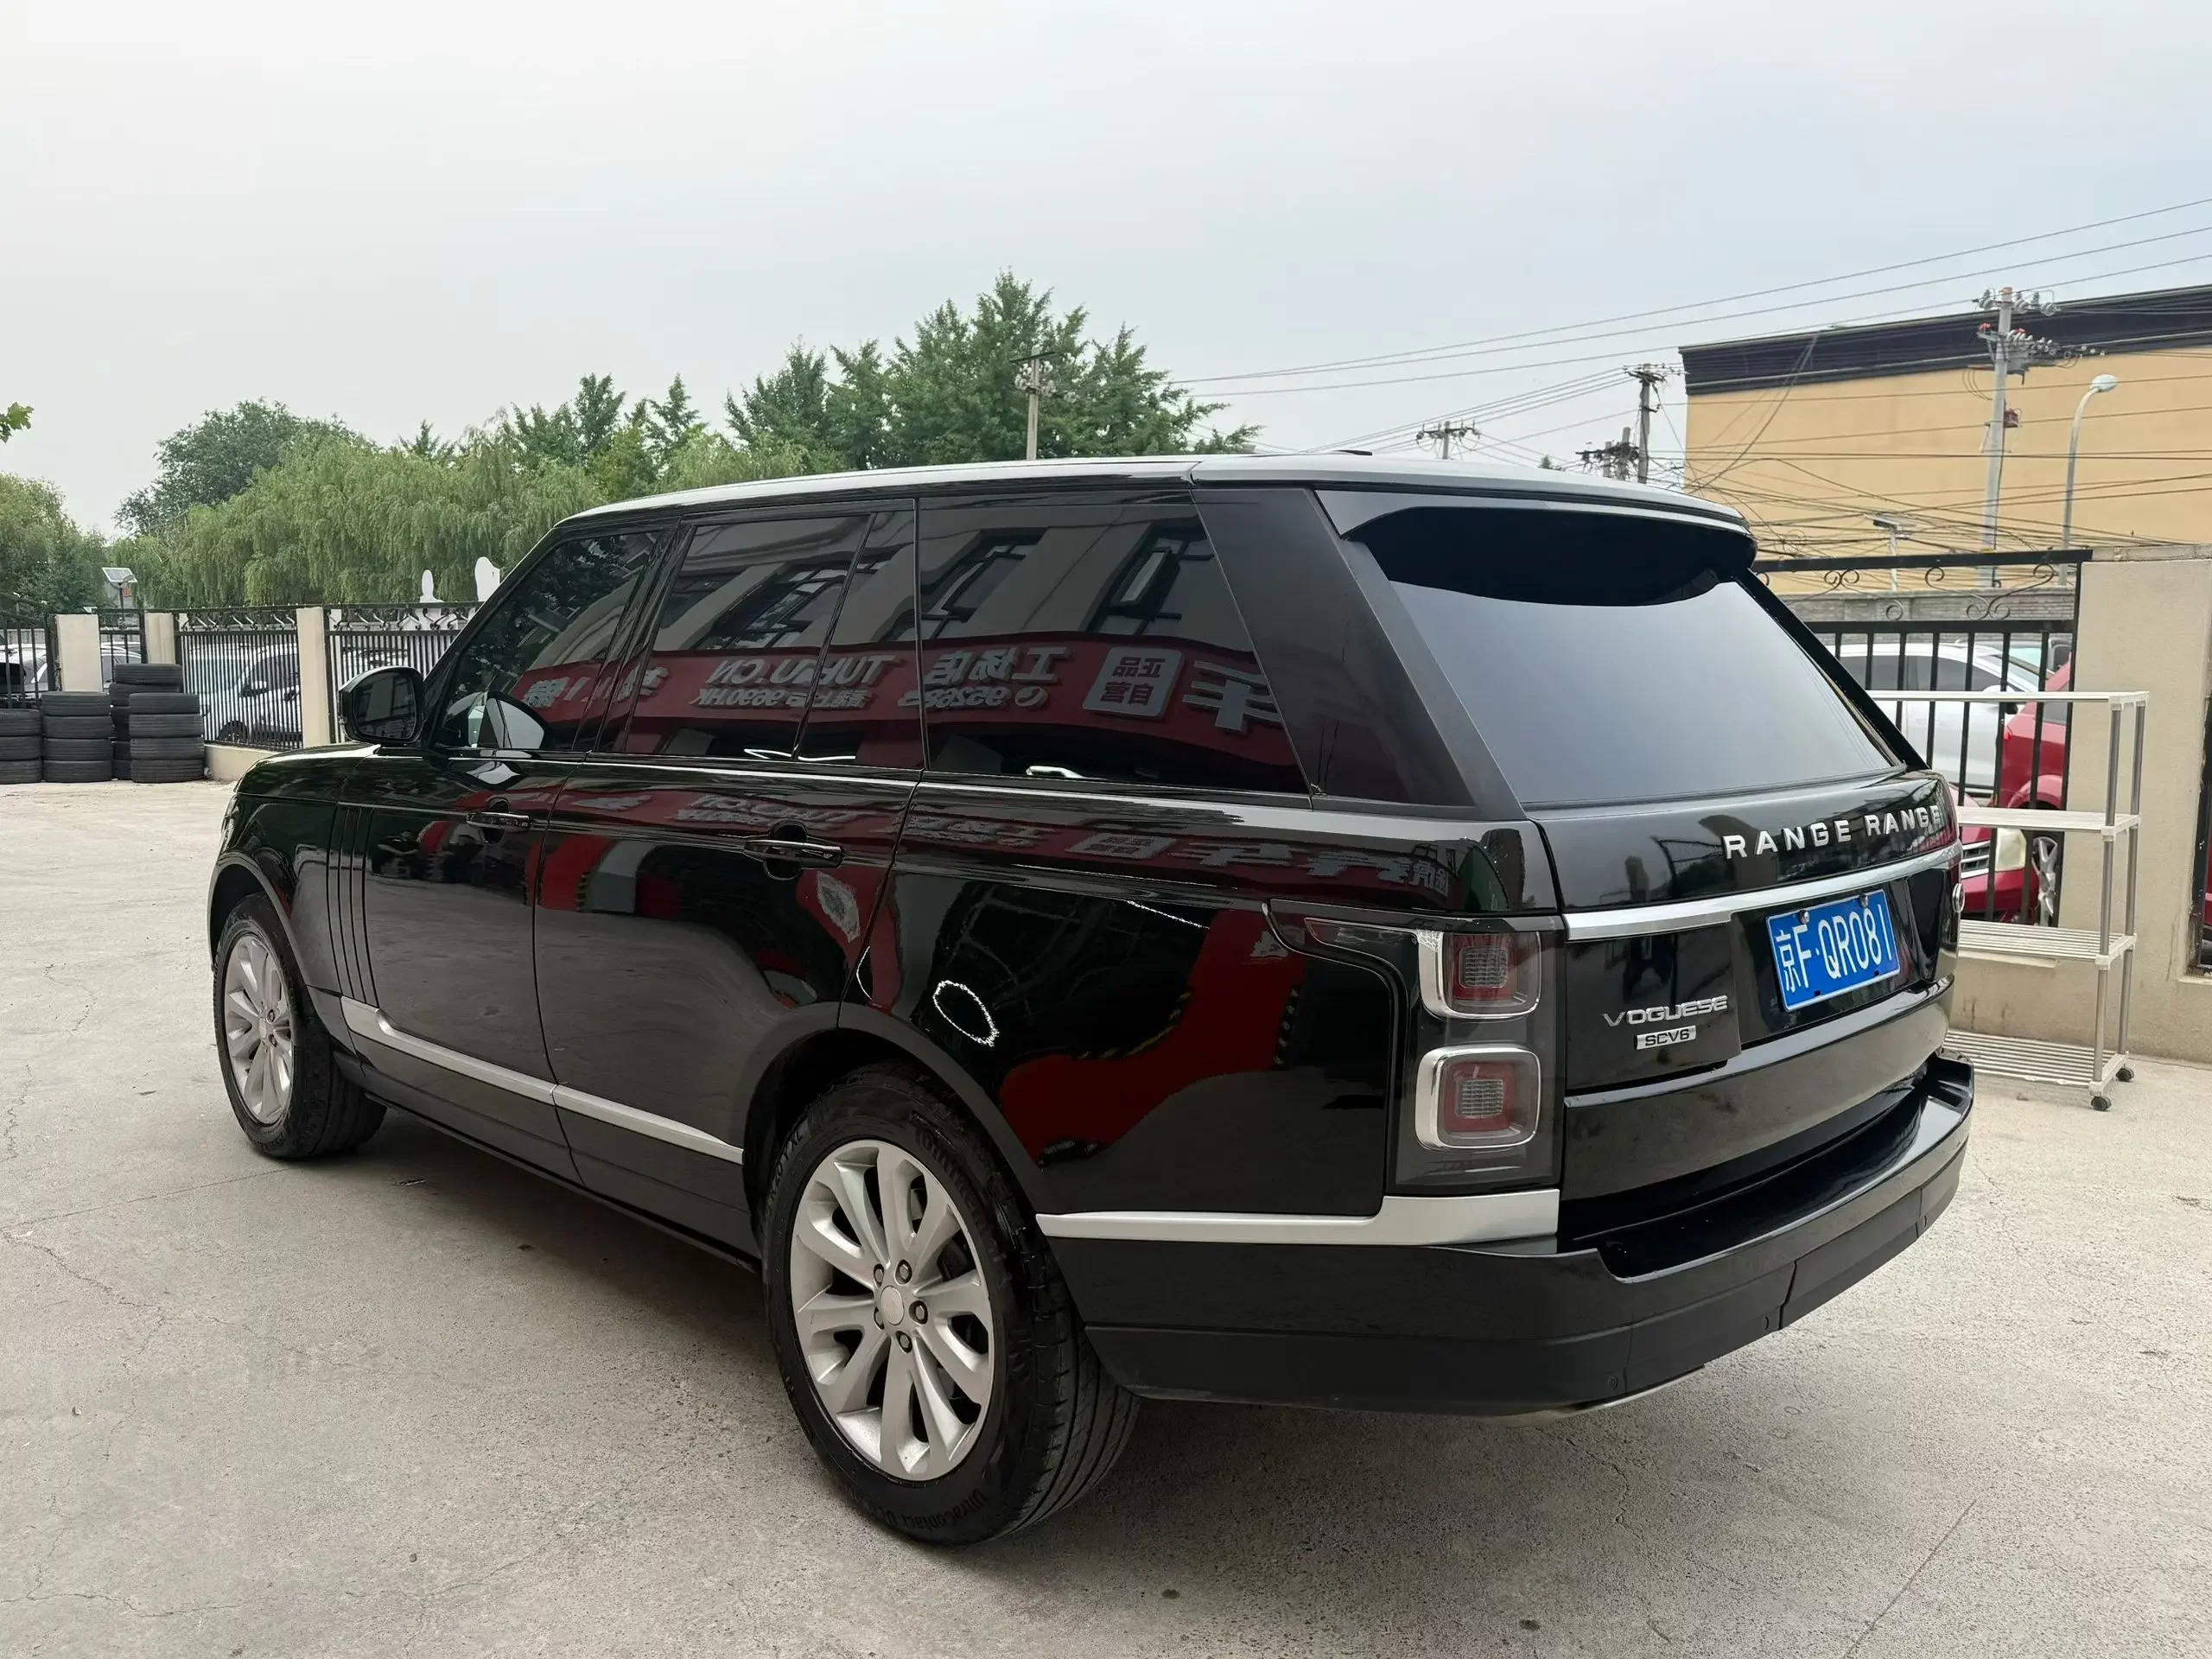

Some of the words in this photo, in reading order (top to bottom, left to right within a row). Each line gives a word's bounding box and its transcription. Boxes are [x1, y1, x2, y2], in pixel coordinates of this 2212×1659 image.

[1721, 819, 1852, 860] RANGE
[1864, 804, 1942, 837] RANGE
[1644, 1027, 1691, 1049] SCV6
